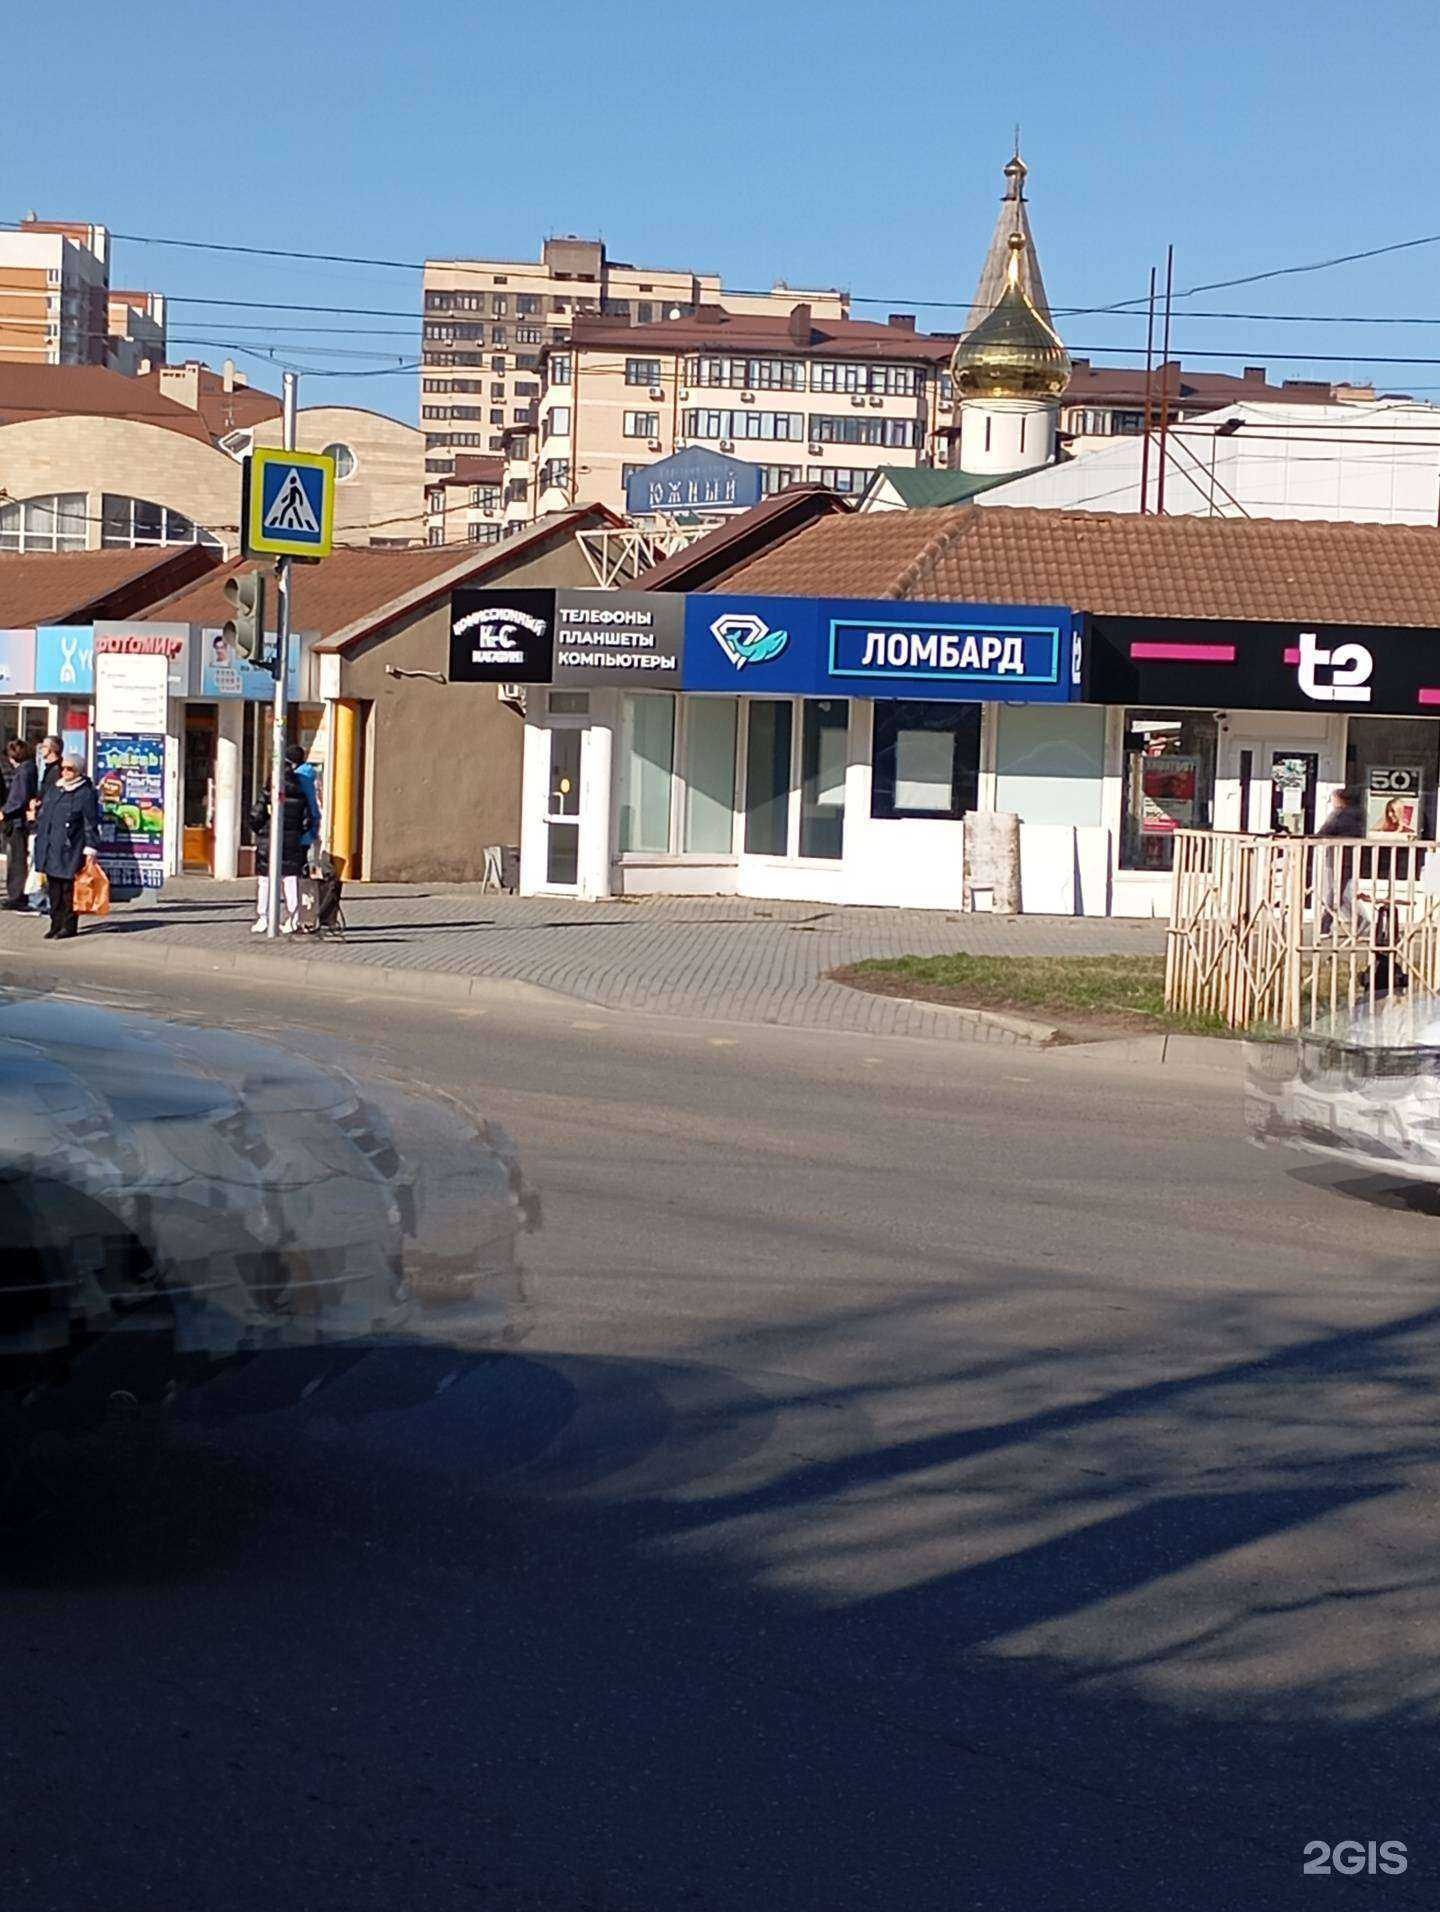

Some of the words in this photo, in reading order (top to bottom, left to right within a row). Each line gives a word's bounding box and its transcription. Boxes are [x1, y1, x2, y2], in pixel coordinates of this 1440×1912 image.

[648, 472, 736, 505] ЮЖНЫЙ
[559, 608, 653, 626] ТЕЛЕФОНЫ
[558, 630, 655, 648] ПЛАНШЕТЫ
[557, 651, 677, 671] КОМПЬЮТЕРЫ
[861, 632, 1025, 675] ЛОМБАРД
[1297, 632, 1374, 702] t2
